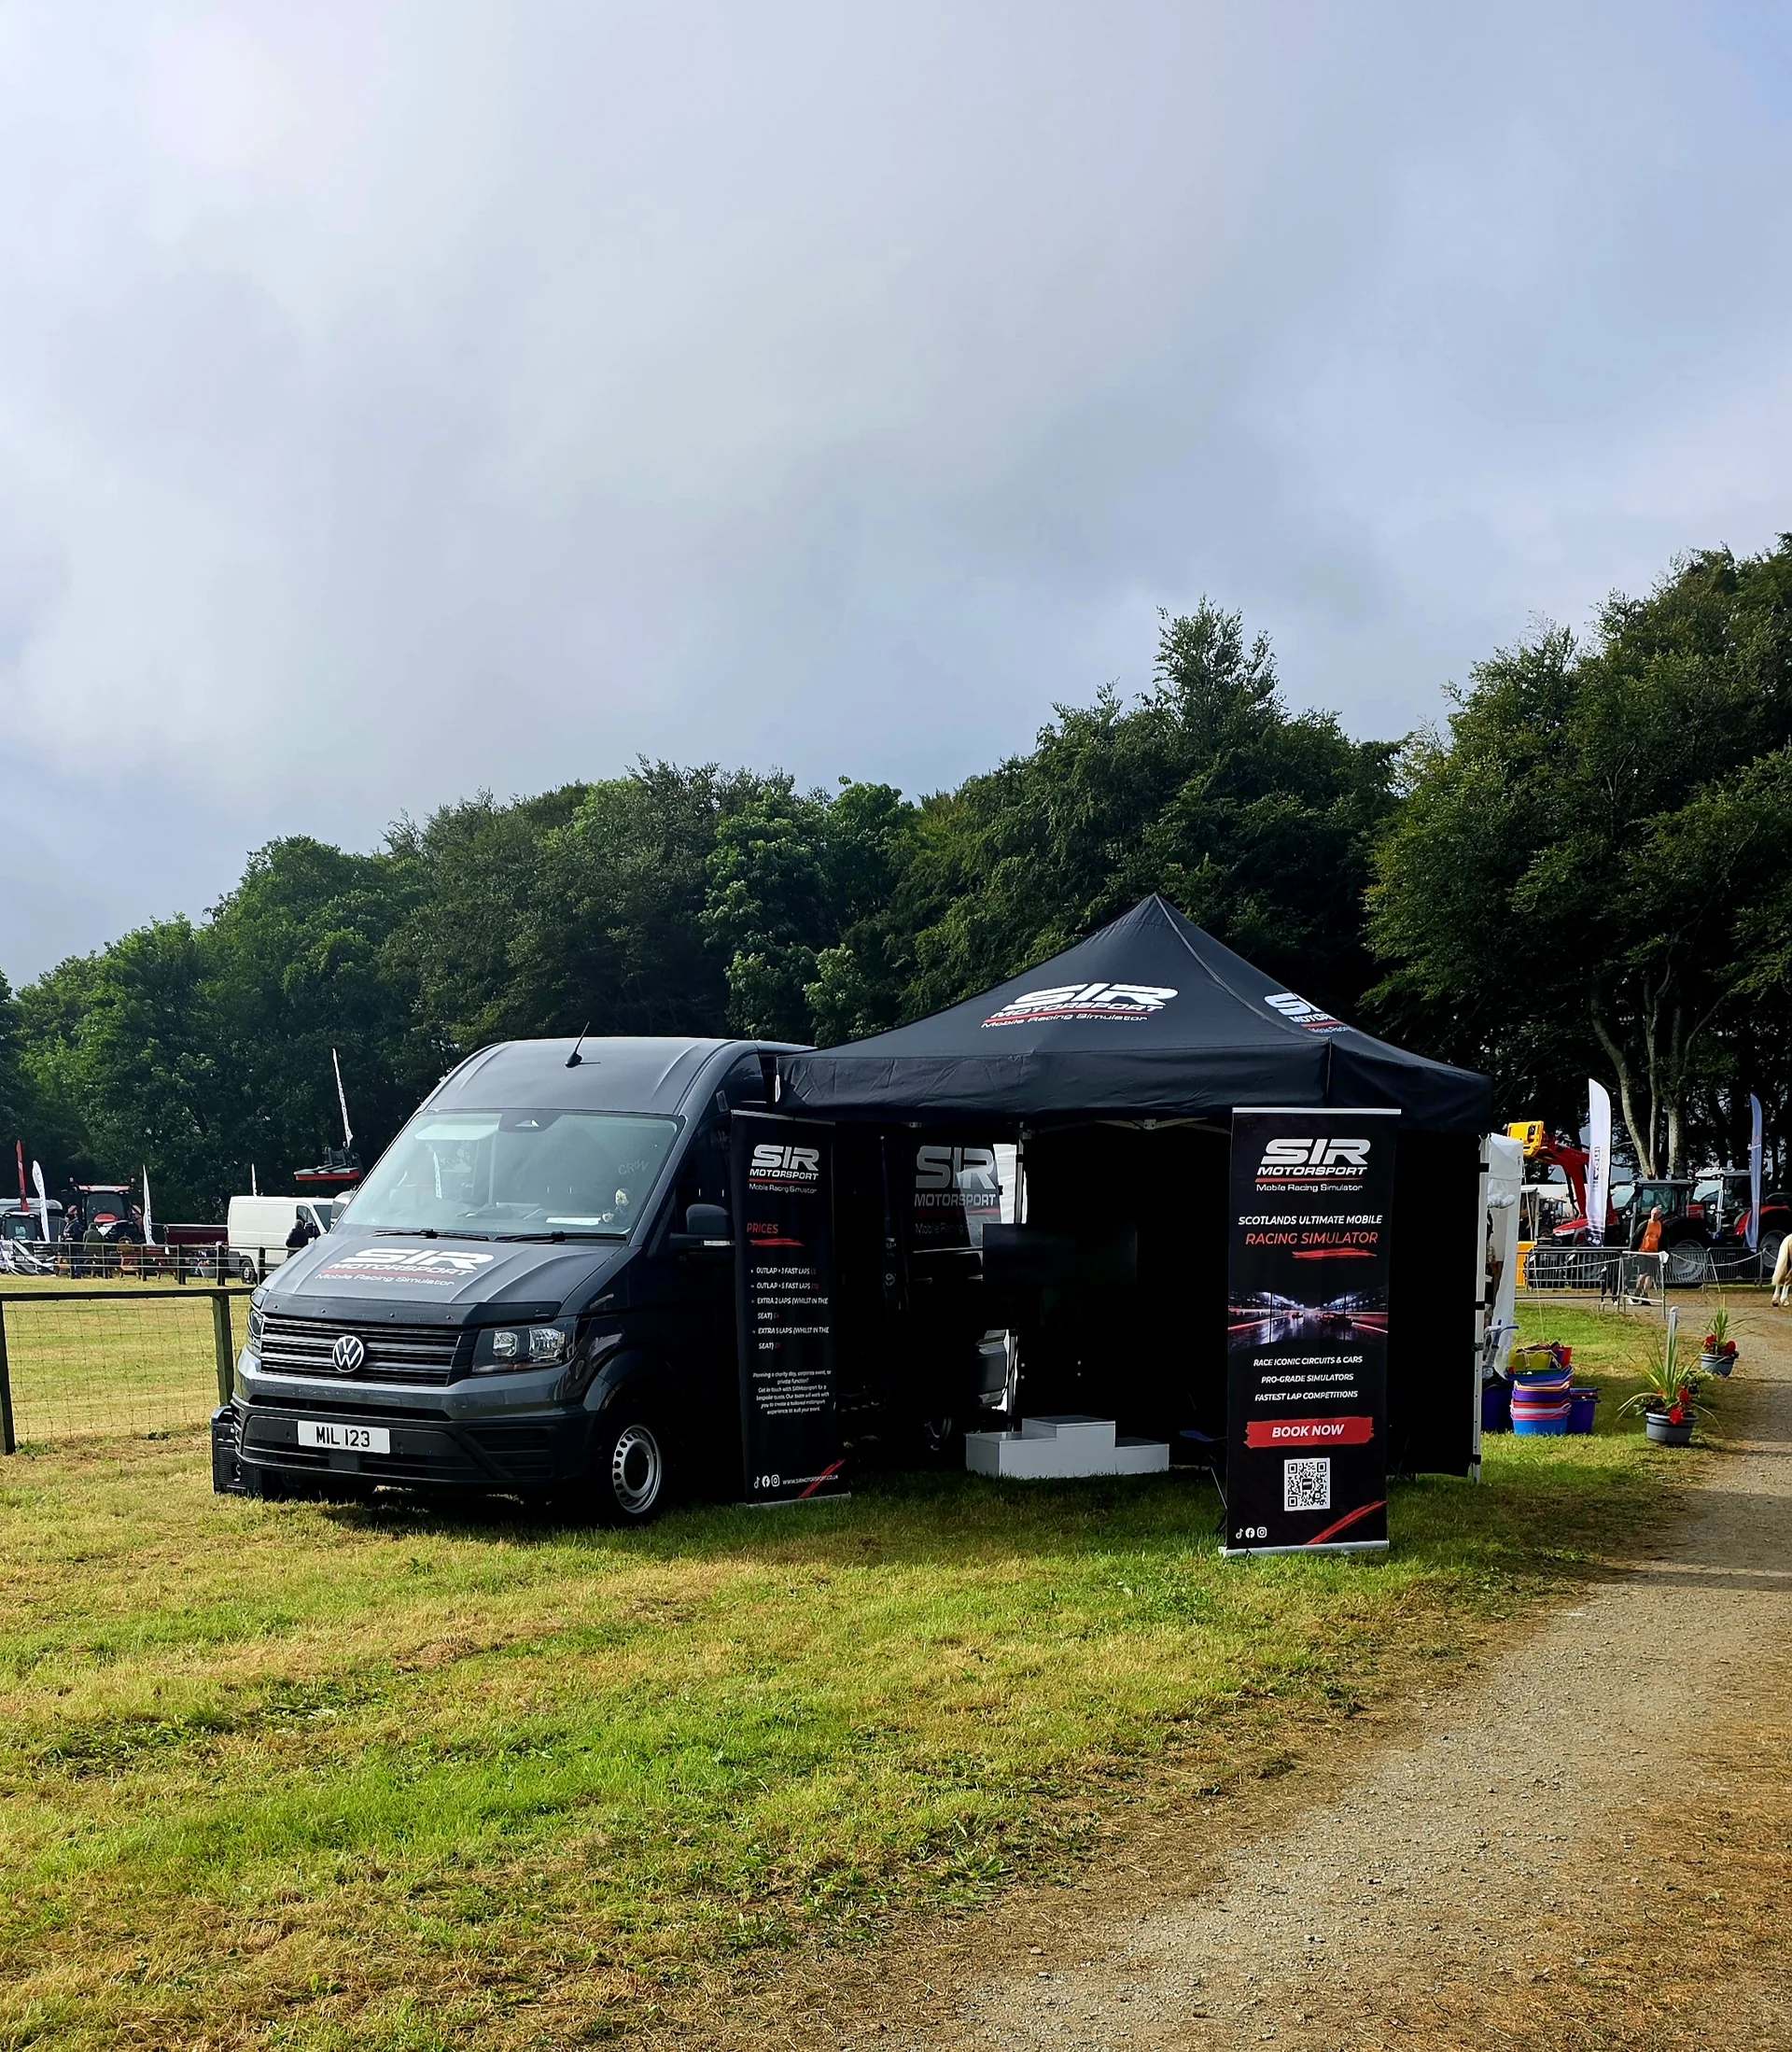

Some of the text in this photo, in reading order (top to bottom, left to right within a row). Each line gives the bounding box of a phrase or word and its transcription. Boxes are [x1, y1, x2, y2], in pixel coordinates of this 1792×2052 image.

[1001, 982, 1179, 1011] SIR
[990, 1002, 1165, 1019] MOTORSPORT
[980, 1012, 1148, 1029] Mobile Racing Simulator
[751, 1144, 819, 1172] SIR
[1260, 1138, 1371, 1165] SIR
[916, 1145, 997, 1189] SIR
[1256, 1166, 1368, 1176] MOTORSPORT
[749, 1168, 819, 1180] MOTORSPORT
[749, 1183, 768, 1191] Mobile
[1287, 1184, 1319, 1193] Racing
[915, 1193, 996, 1207] MOTORSPORT
[1238, 1215, 1383, 1226] SCOTLANDS ULTIMATE MOBILE
[747, 1222, 778, 1234] PRICES
[1245, 1231, 1379, 1245] RACING SIMULATOR
[340, 1247, 495, 1271] SIR
[327, 1263, 474, 1276] MOTORSPORT
[315, 1272, 455, 1286] Mobile Racing Simulator
[757, 1312, 773, 1320] SEAT)
[758, 1327, 775, 1335] EXTRA
[758, 1342, 774, 1350] SEAT)
[1253, 1358, 1273, 1367] RACE
[1273, 1357, 1301, 1366] ICONIC
[1301, 1356, 1336, 1365] CIRCUITS
[1342, 1356, 1364, 1364] CARS
[1261, 1373, 1354, 1384] PRO-GRADE SIMULATORS
[1254, 1390, 1359, 1401] FASTEST LAP COMPETITIONS
[315, 1426, 371, 1448] MIL 123
[1271, 1424, 1345, 1438] BOOK NOW
